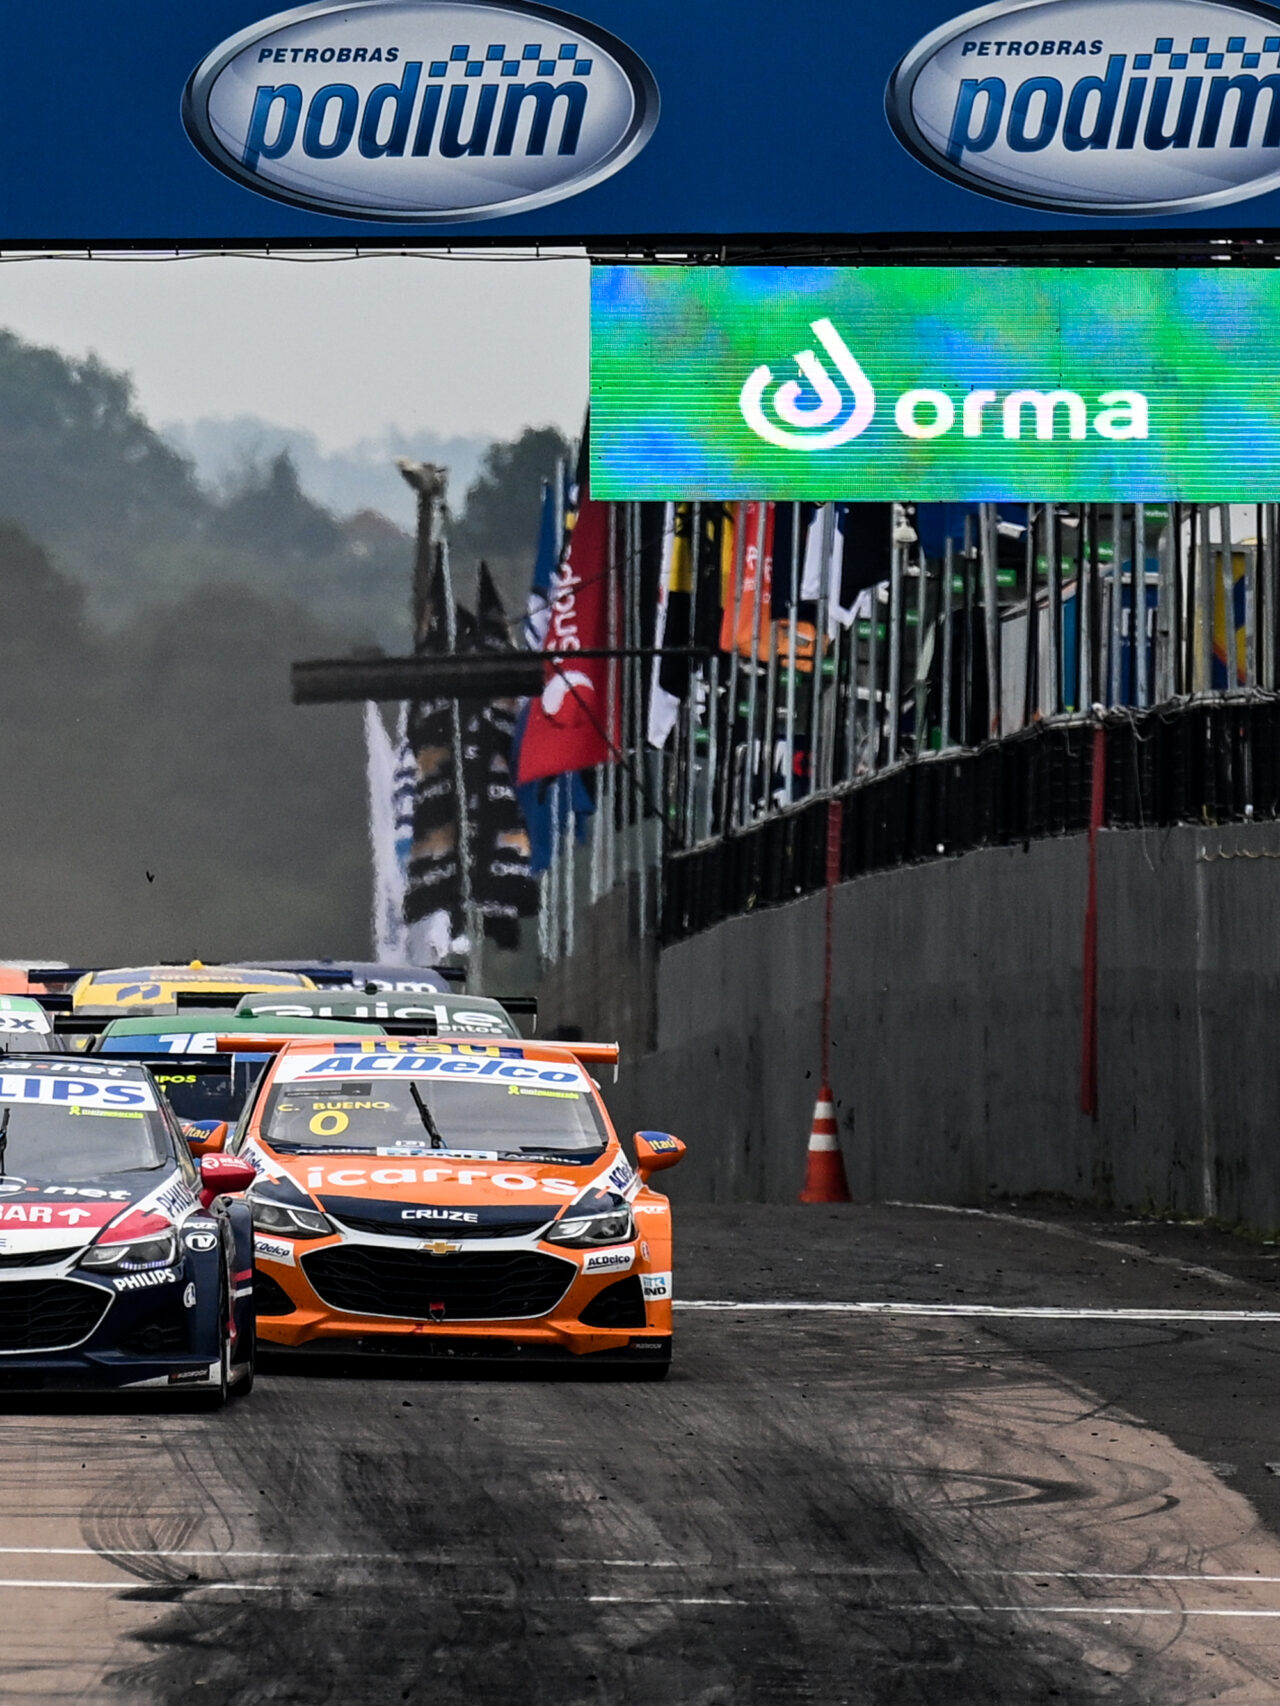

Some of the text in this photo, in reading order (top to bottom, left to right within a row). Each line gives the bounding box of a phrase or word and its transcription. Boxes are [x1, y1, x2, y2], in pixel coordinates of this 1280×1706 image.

[257, 47, 400, 63] PETROBRAS
[961, 40, 1103, 57] PETROBRAS
[241, 61, 589, 173] podium
[305, 1055, 579, 1083] ACDelco
[312, 1101, 391, 1111] BUENO
[307, 1167, 579, 1196] icarros
[402, 1209, 478, 1223] CRUZE
[255, 1241, 290, 1257] CDelco
[588, 1255, 631, 1267] ACDelco
[113, 1268, 176, 1291] PHILIPS
